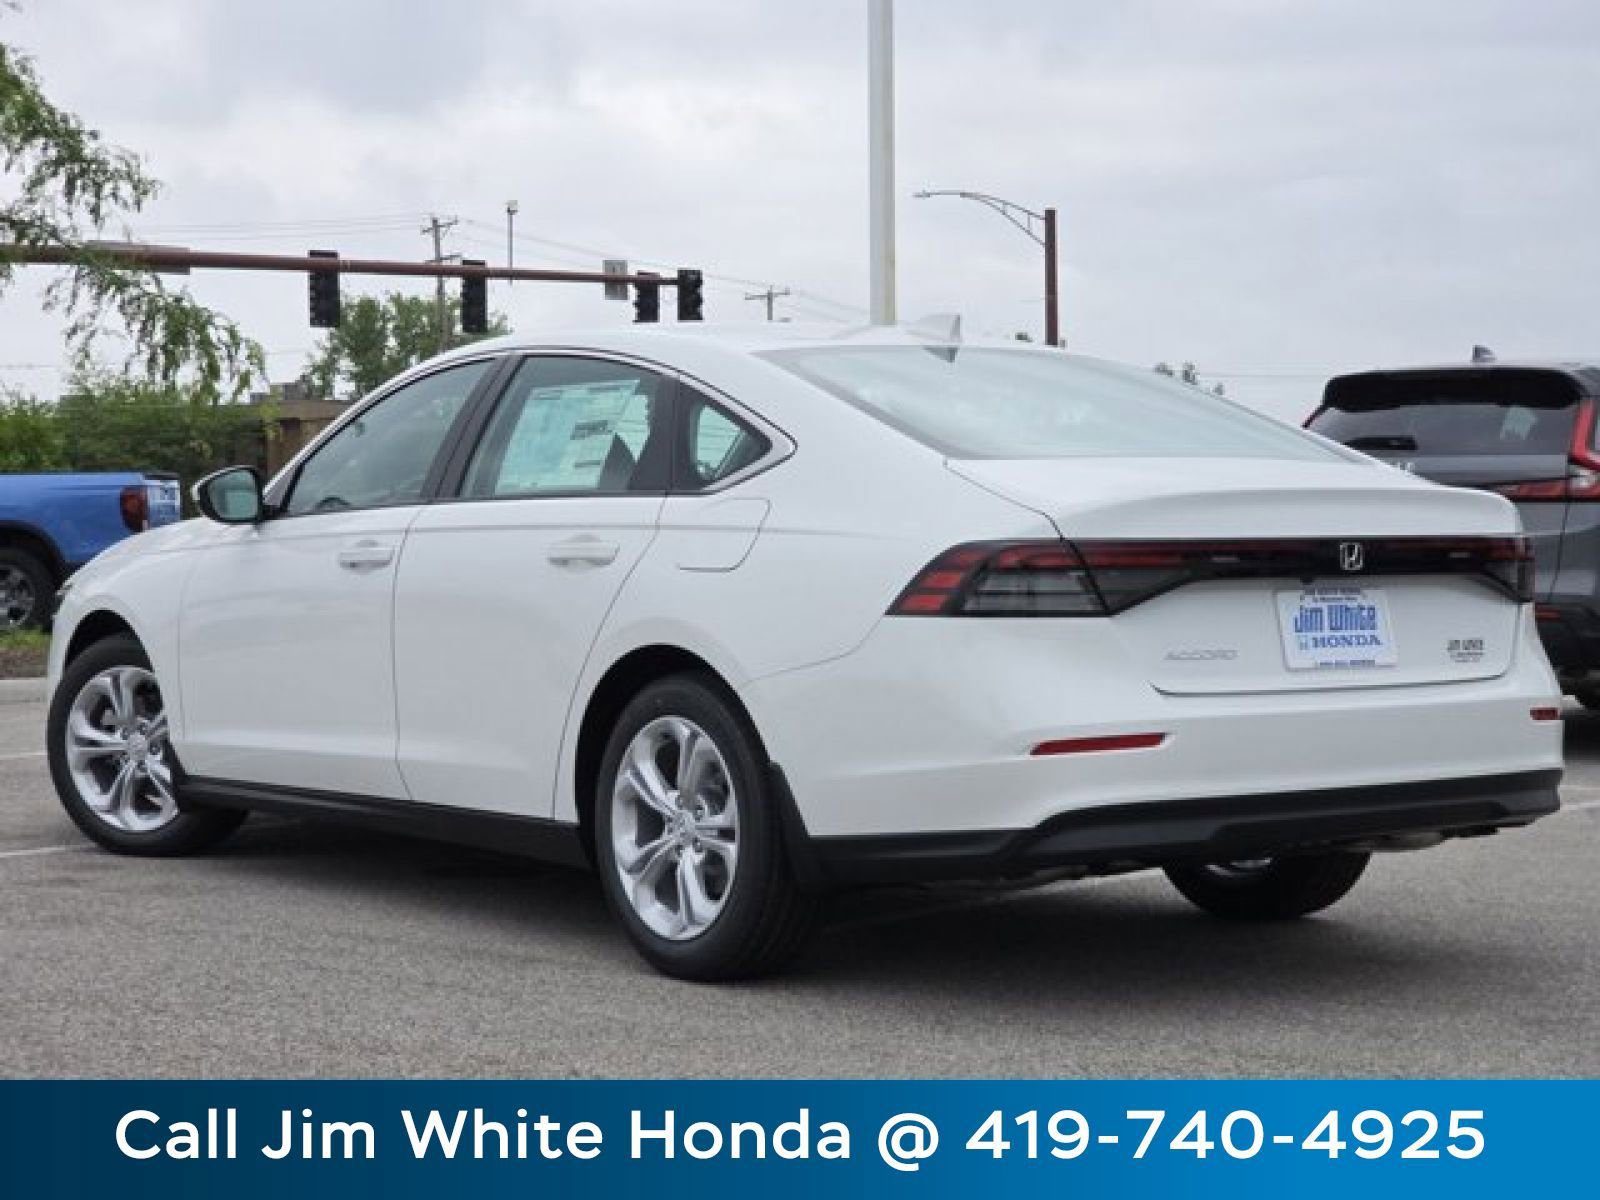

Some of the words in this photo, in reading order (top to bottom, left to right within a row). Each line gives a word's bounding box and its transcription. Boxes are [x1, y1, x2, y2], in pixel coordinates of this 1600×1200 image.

[1294, 604, 1323, 633] Jim
[1327, 603, 1376, 631] White
[1311, 634, 1384, 649] HONDA
